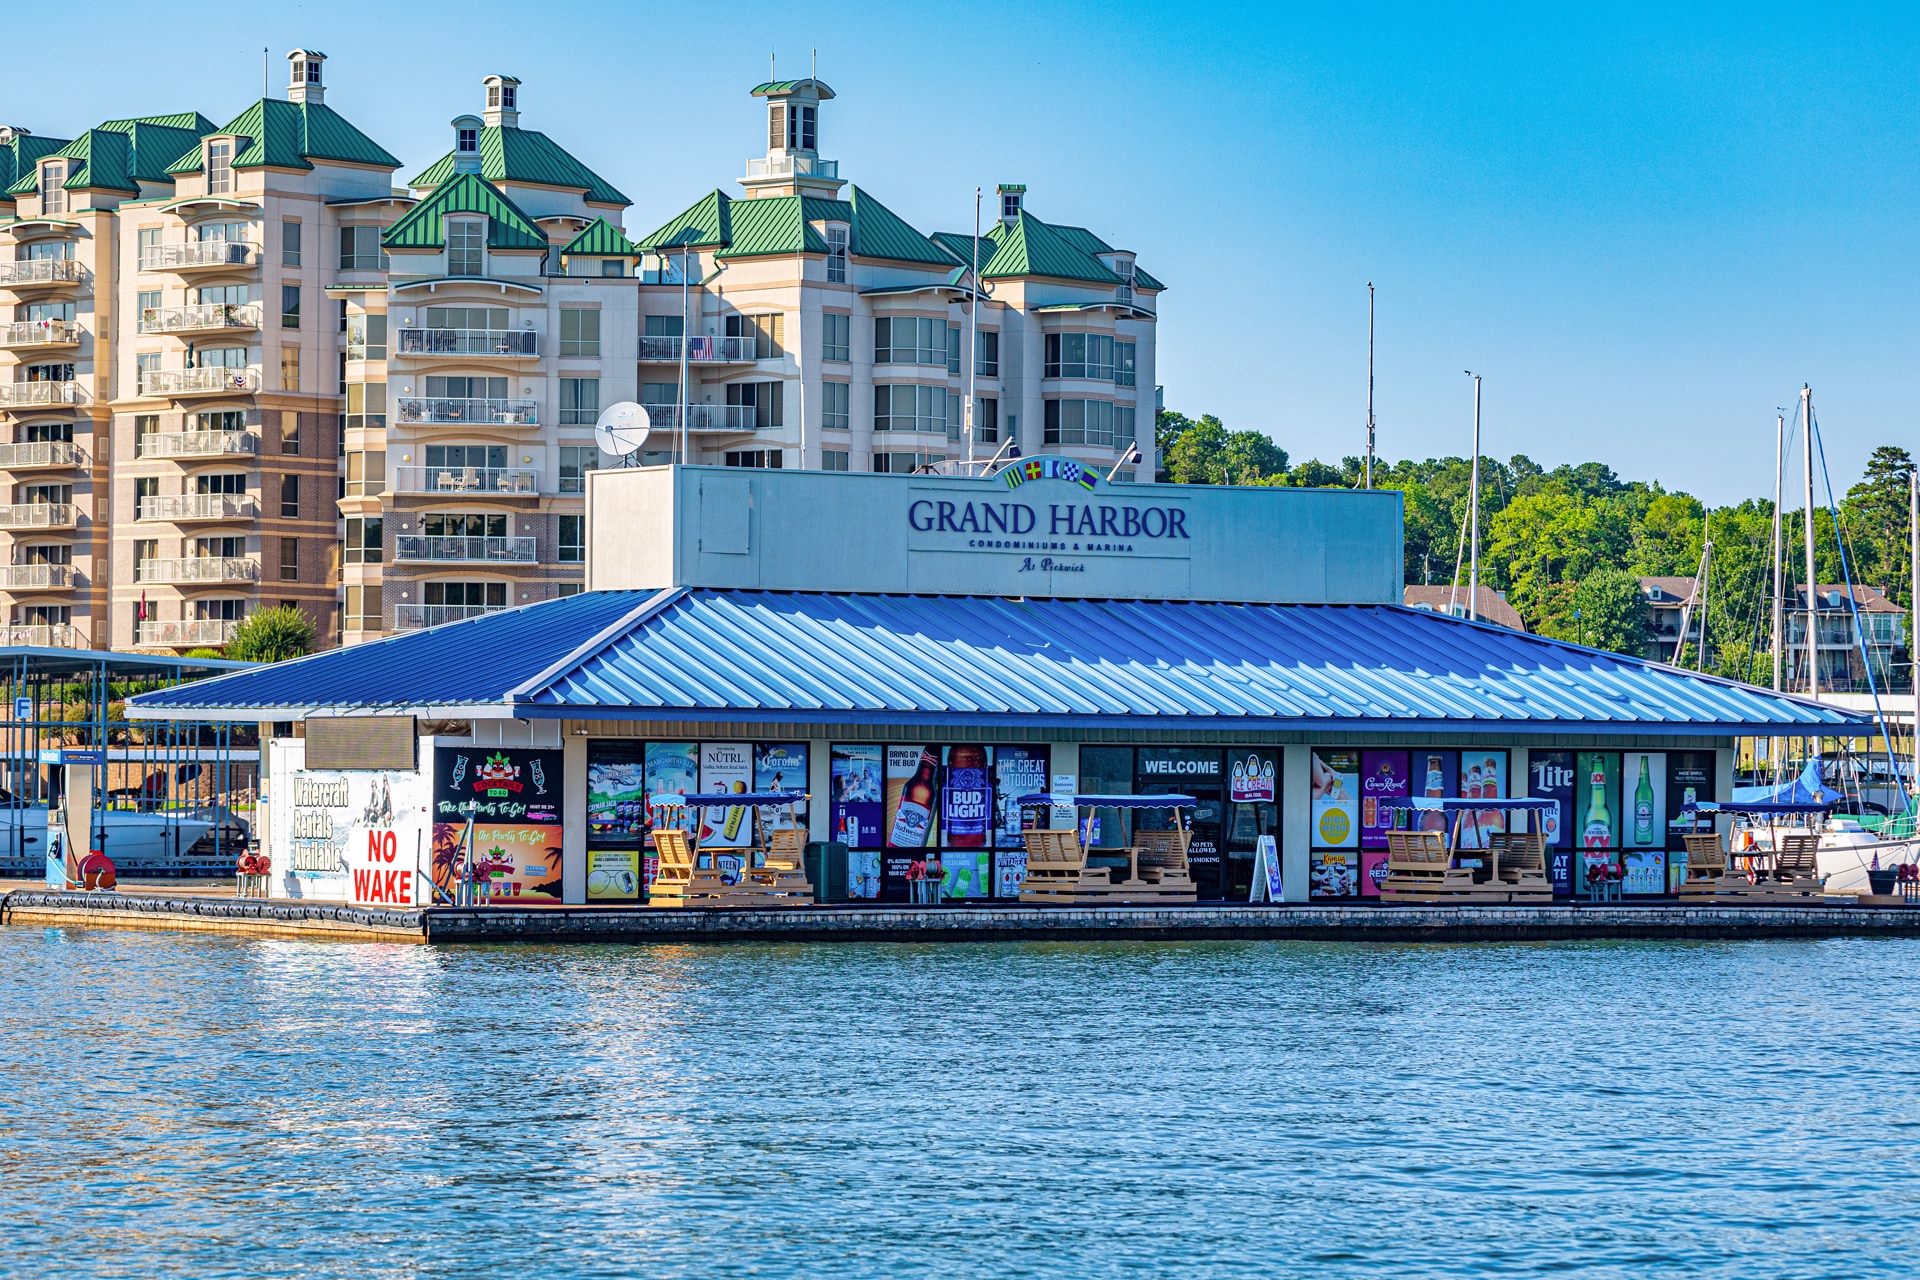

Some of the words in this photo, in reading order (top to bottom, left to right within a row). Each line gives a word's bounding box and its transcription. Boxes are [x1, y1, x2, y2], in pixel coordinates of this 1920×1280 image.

[908, 500, 1036, 534] GRAND
[1049, 504, 1190, 539] HARBOR
[969, 538, 1067, 550] CONDOMINIUMS
[1087, 542, 1134, 552] MARINA
[1018, 557, 1036, 573] At
[1041, 557, 1086, 573] Pickwick
[18, 700, 30, 716] F
[889, 750, 908, 758] BRING
[910, 751, 919, 759] ON
[647, 756, 695, 769] MARGARITAVILLE
[762, 755, 800, 769] Corona
[889, 759, 901, 767] THE
[998, 760, 1016, 772] THE
[1018, 760, 1046, 773] GREAT
[1145, 760, 1219, 774] WELCOME
[476, 780, 520, 790] COCKTAILS
[1000, 774, 1046, 787] OUTDOORS
[1234, 780, 1244, 791] ICE
[1246, 779, 1272, 790] CREAM
[1364, 777, 1384, 791] Crown
[1378, 777, 1406, 792] Royal
[1537, 766, 1574, 792] Lite
[294, 776, 348, 808] Watercraft
[952, 792, 982, 804] BUD
[438, 800, 458, 814] Take
[605, 800, 617, 808] JACK
[948, 804, 985, 818] LIGHT
[294, 809, 334, 840] Rentals
[895, 822, 924, 839] Budweiser
[478, 830, 490, 840] the
[492, 830, 516, 843] Party
[368, 830, 397, 863] NO
[294, 841, 342, 872] Available
[998, 858, 1023, 868] VINTAGE
[718, 860, 738, 870] NTEEN
[354, 868, 412, 904] WAKE
